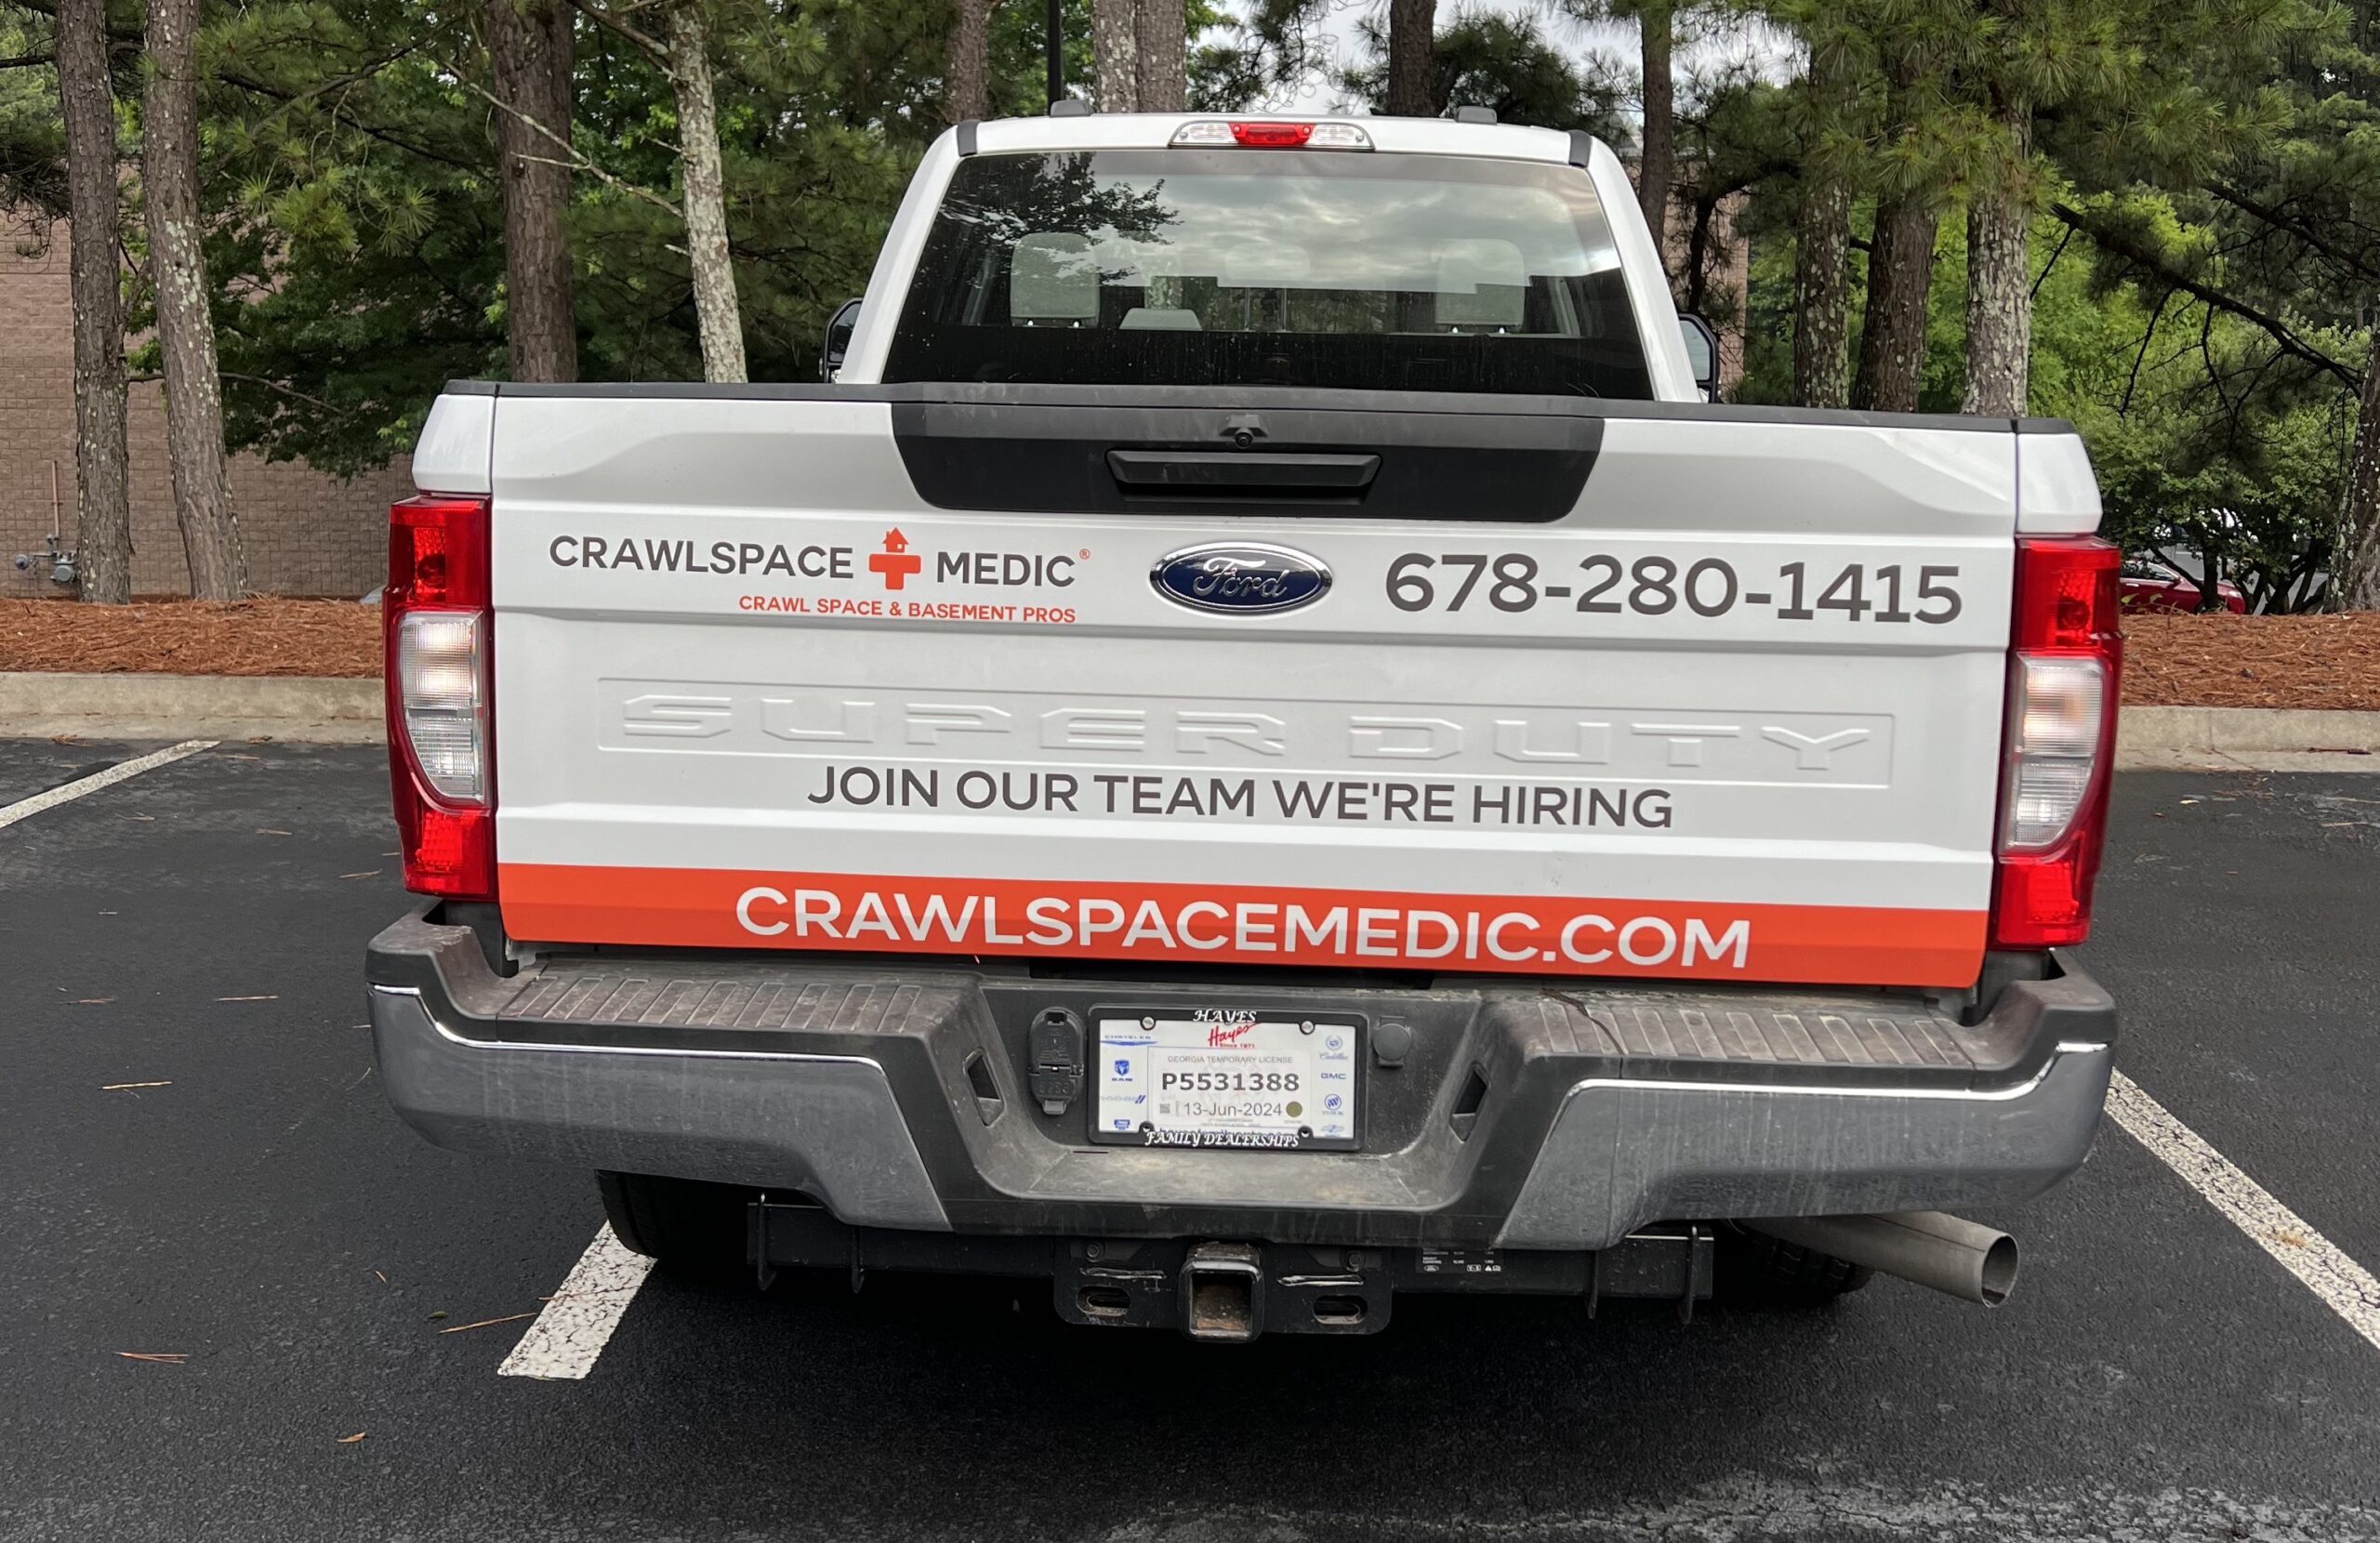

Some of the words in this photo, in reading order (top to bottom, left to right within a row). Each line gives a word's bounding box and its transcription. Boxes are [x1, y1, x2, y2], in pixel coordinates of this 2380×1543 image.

[549, 534, 855, 580] CRAWLSPACE
[1193, 557, 1290, 598] Ford
[1384, 551, 1963, 626] 678-280-1415
[738, 595, 811, 614] CRAWL
[817, 598, 883, 617] SPACE
[890, 602, 903, 617] &
[908, 603, 1017, 622] BASEMENT
[1023, 607, 1077, 624] PROS
[623, 694, 1286, 757] SUPER
[1349, 716, 1871, 771] DUTY
[806, 764, 939, 808] JOIN
[955, 770, 1079, 812] OUR
[1093, 773, 1255, 817] TEAM
[1271, 779, 1456, 823] WE'RE
[1472, 784, 1673, 828] HIRING
[735, 886, 1751, 969] CRAWLSPACEMEDIC.COM
[1192, 1009, 1257, 1025] HAYES
[1208, 1022, 1258, 1047] Hayes
[1167, 1055, 1206, 1063] GEORGIA
[1207, 1055, 1257, 1064] TEMPORARY
[1258, 1056, 1294, 1064] LICENSE
[1161, 1072, 1301, 1092] P5531388
[1320, 1072, 1347, 1080] GMC
[1183, 1101, 1283, 1117] 13-Jun-2024
[1144, 1129, 1201, 1147] FAMILY
[1203, 1131, 1300, 1148] DEALERSHIPS
